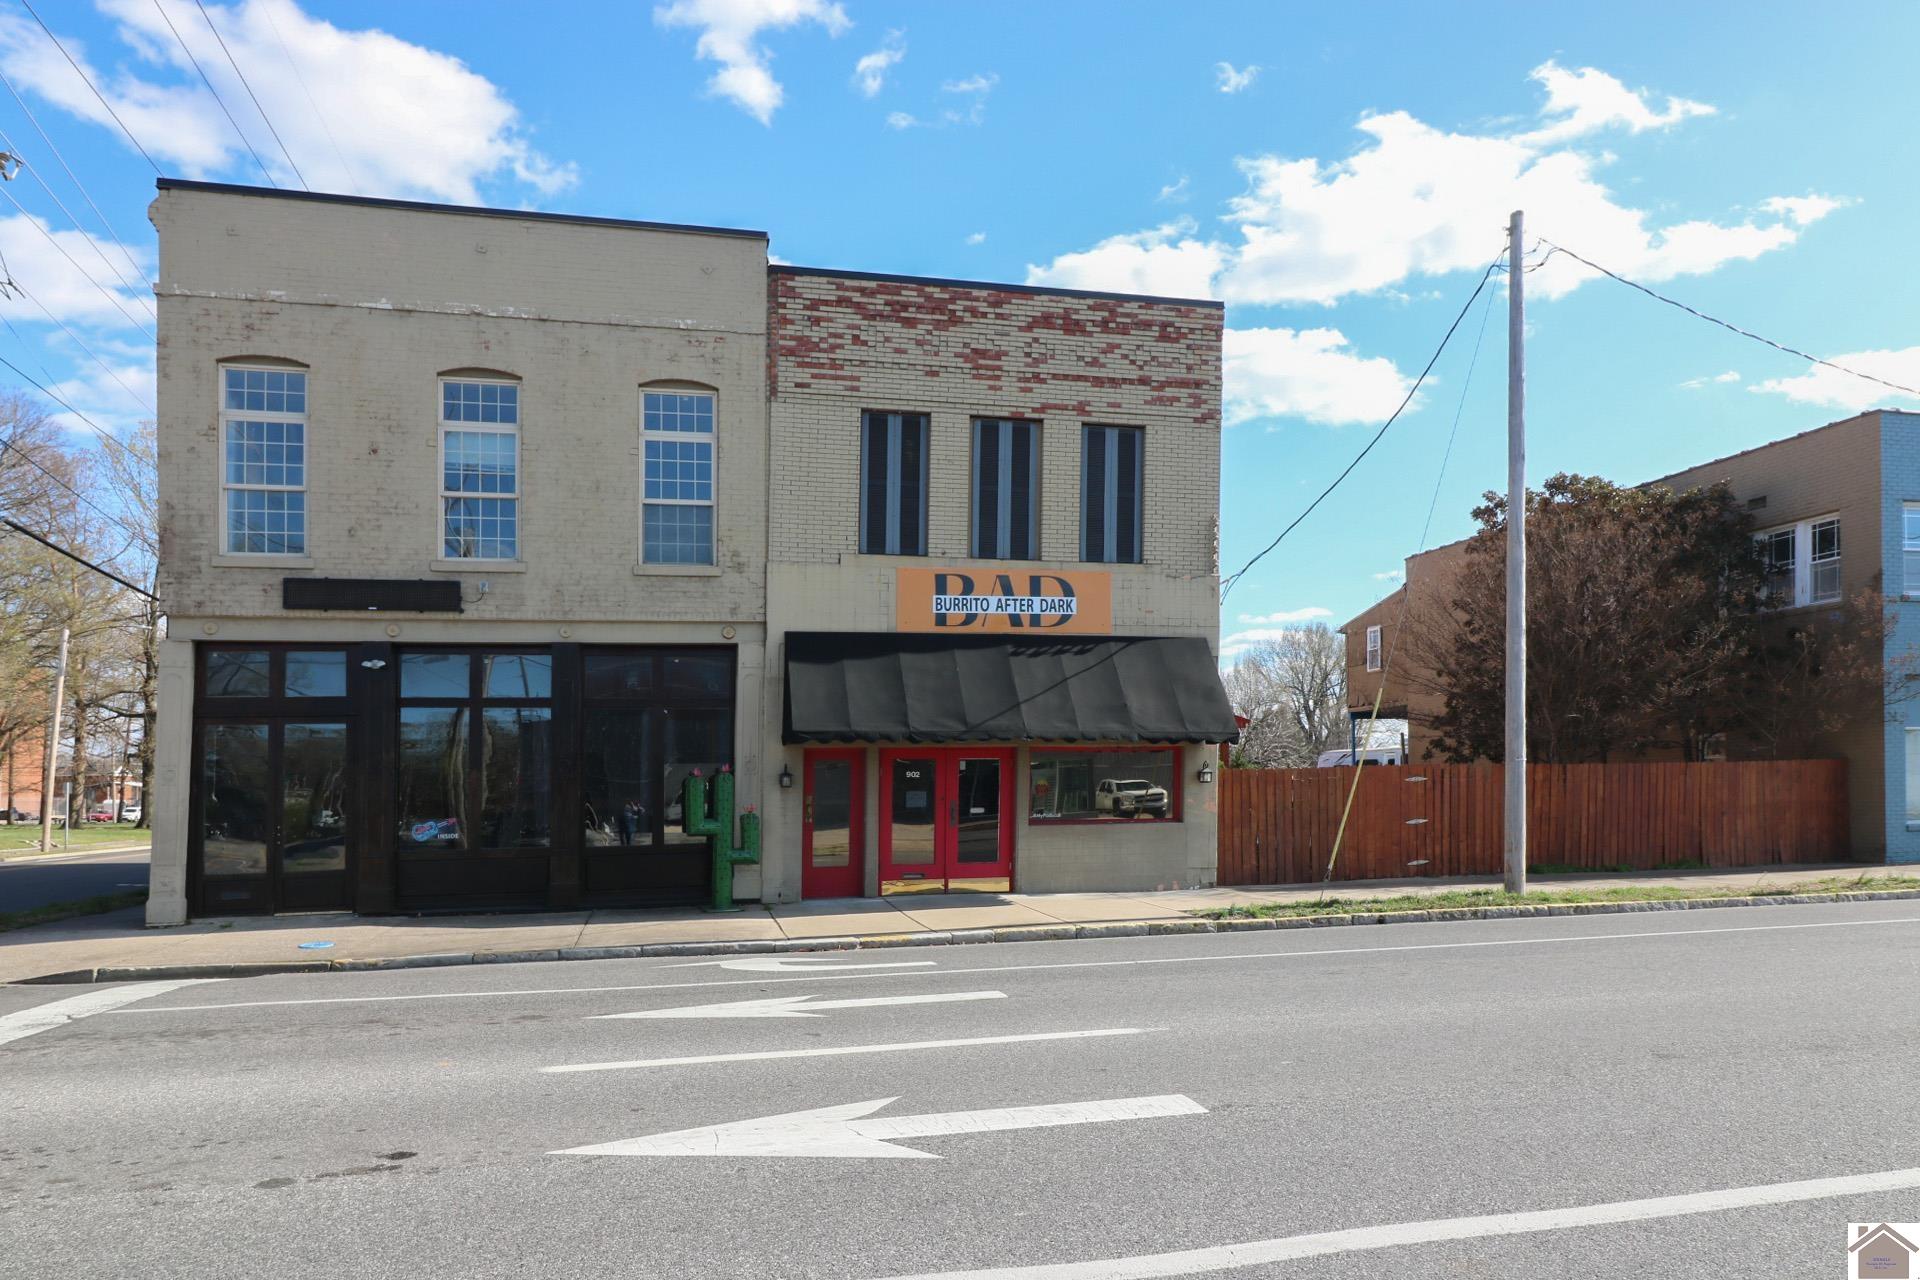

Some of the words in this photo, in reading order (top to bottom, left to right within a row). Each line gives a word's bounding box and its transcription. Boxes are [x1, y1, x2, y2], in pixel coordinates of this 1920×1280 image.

[934, 573, 1076, 628] BAD
[935, 597, 990, 612] BURRITO
[995, 598, 1034, 613] AFTER
[1039, 598, 1074, 613] DARK
